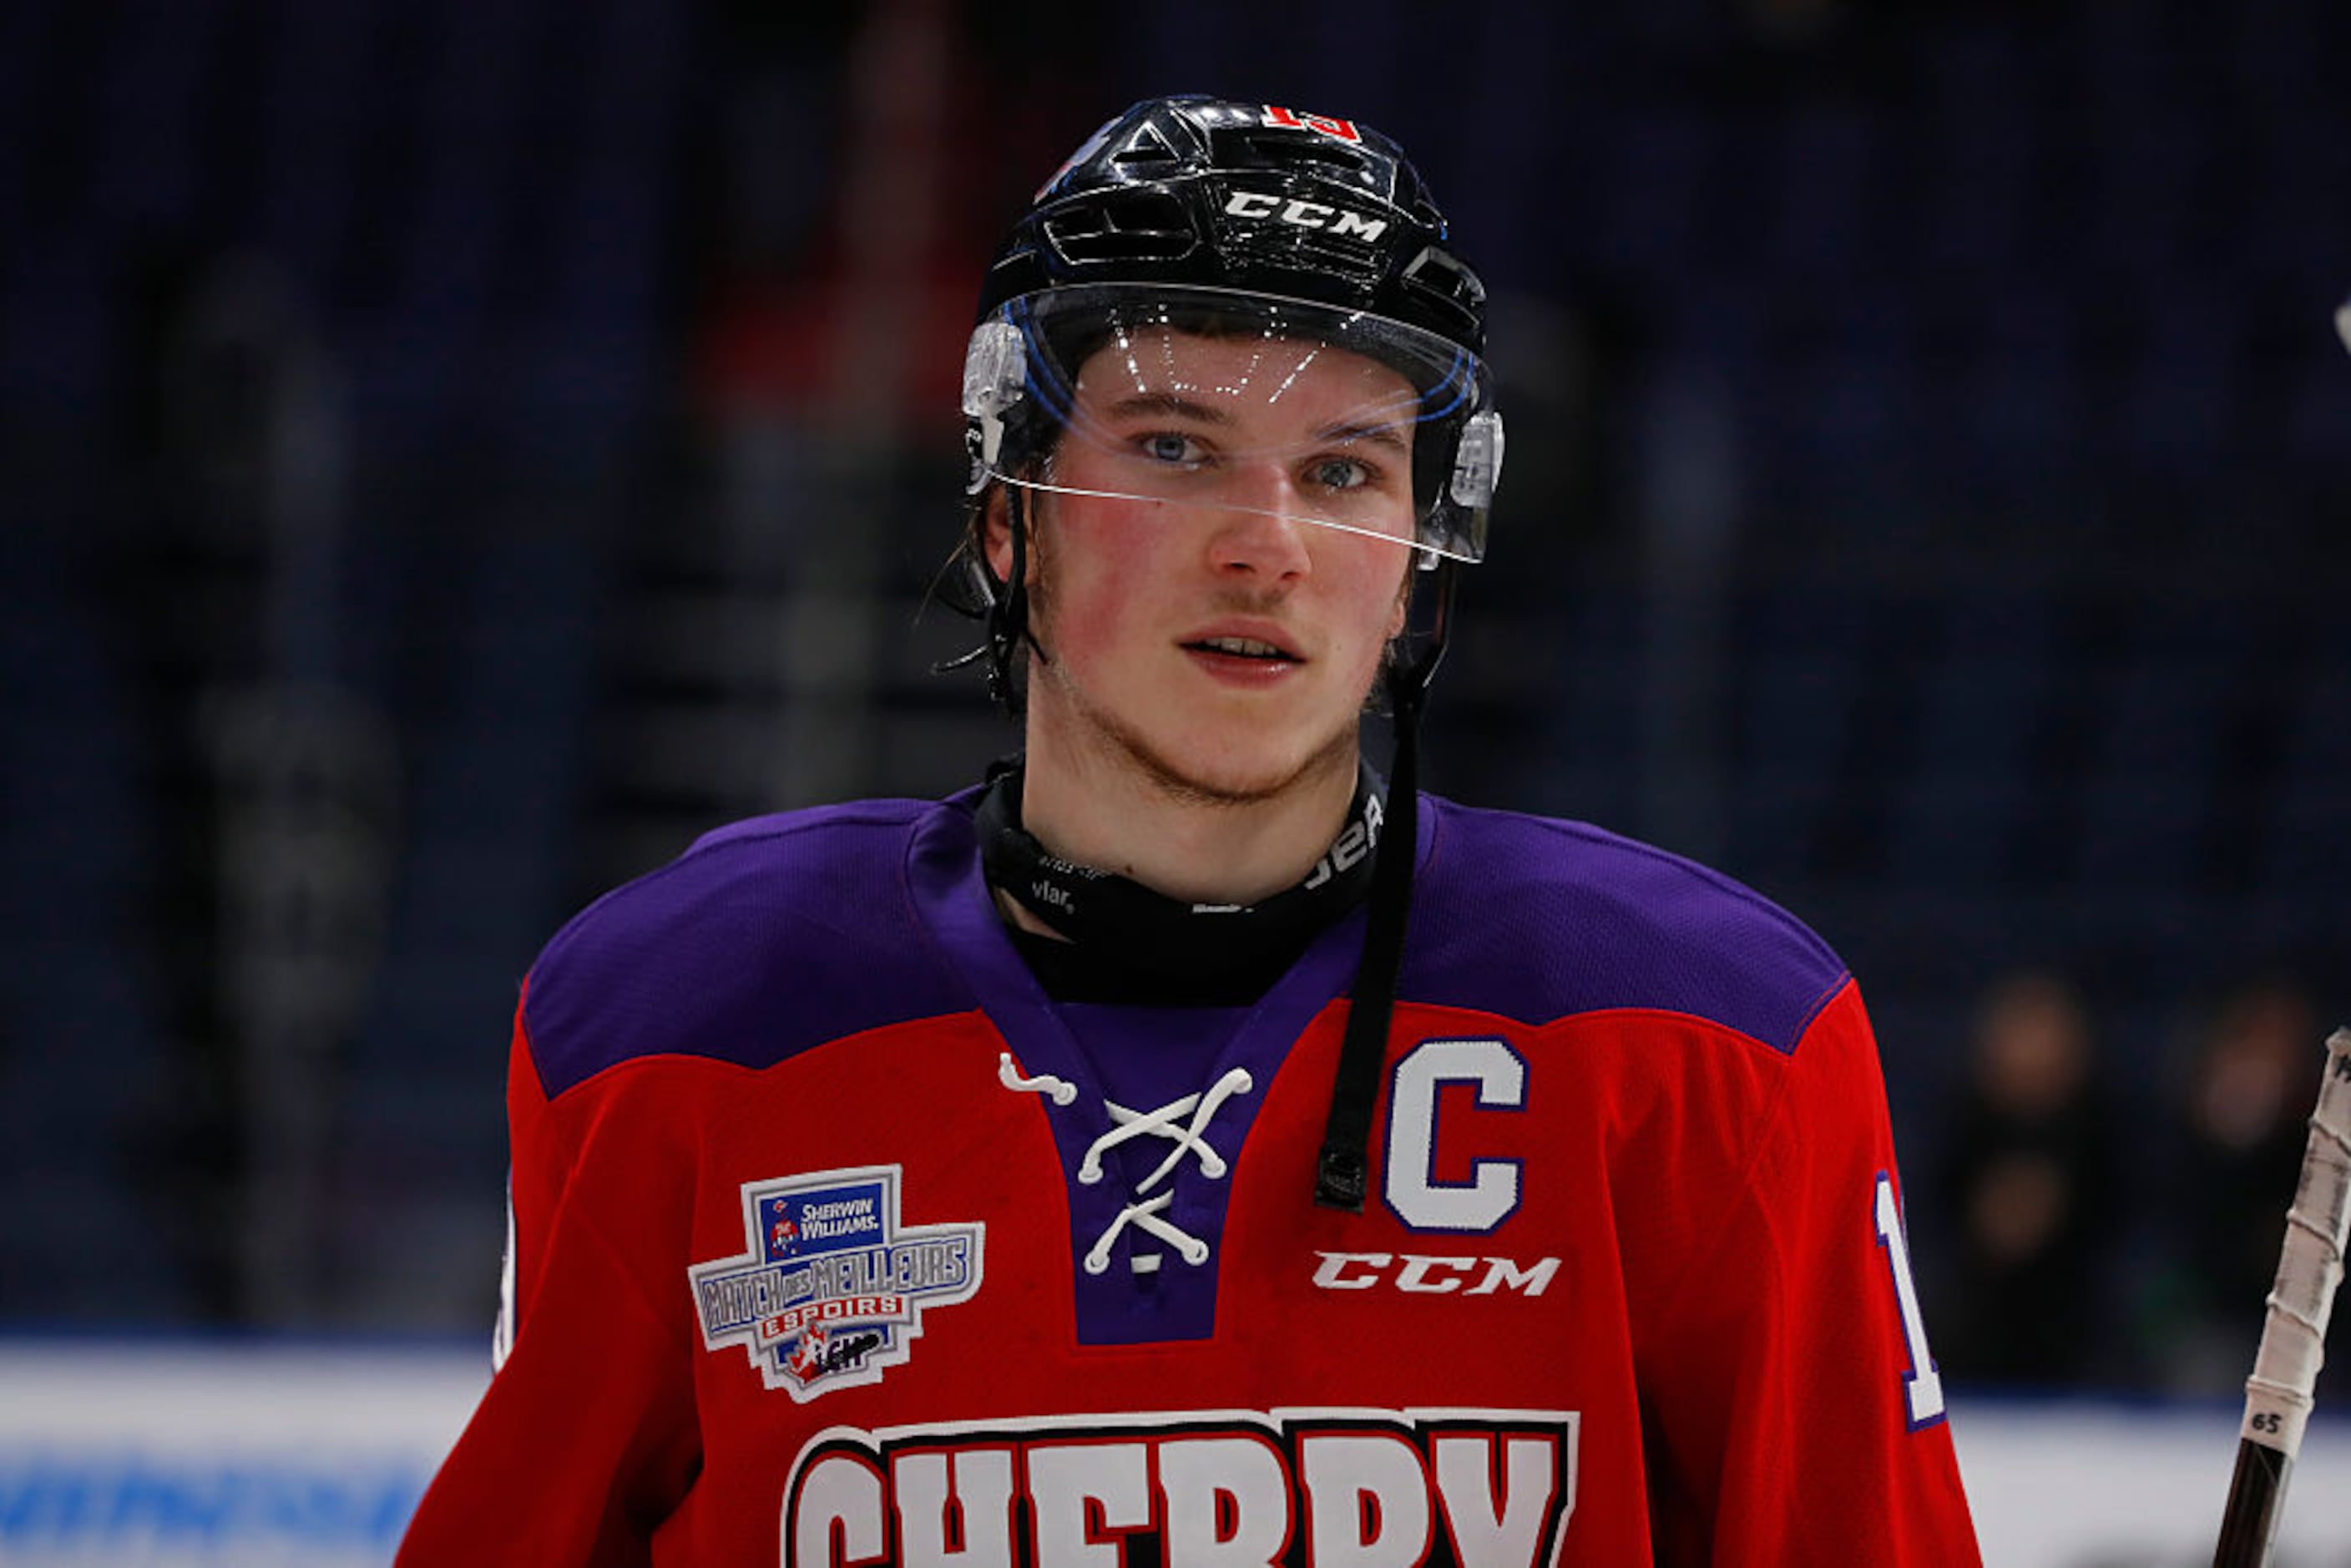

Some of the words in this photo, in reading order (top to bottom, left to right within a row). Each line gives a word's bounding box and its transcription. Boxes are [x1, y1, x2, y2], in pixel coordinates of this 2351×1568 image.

[1225, 190, 1387, 242] CCM
[1383, 1036, 1529, 1236] C
[801, 1198, 873, 1222] SHERWIN
[703, 1269, 783, 1329] MATCH
[810, 1240, 967, 1299] MEILLEURS
[1312, 1251, 1562, 1297] CCM
[765, 1296, 897, 1336] ESPOIRS
[2252, 1413, 2283, 1434] 65
